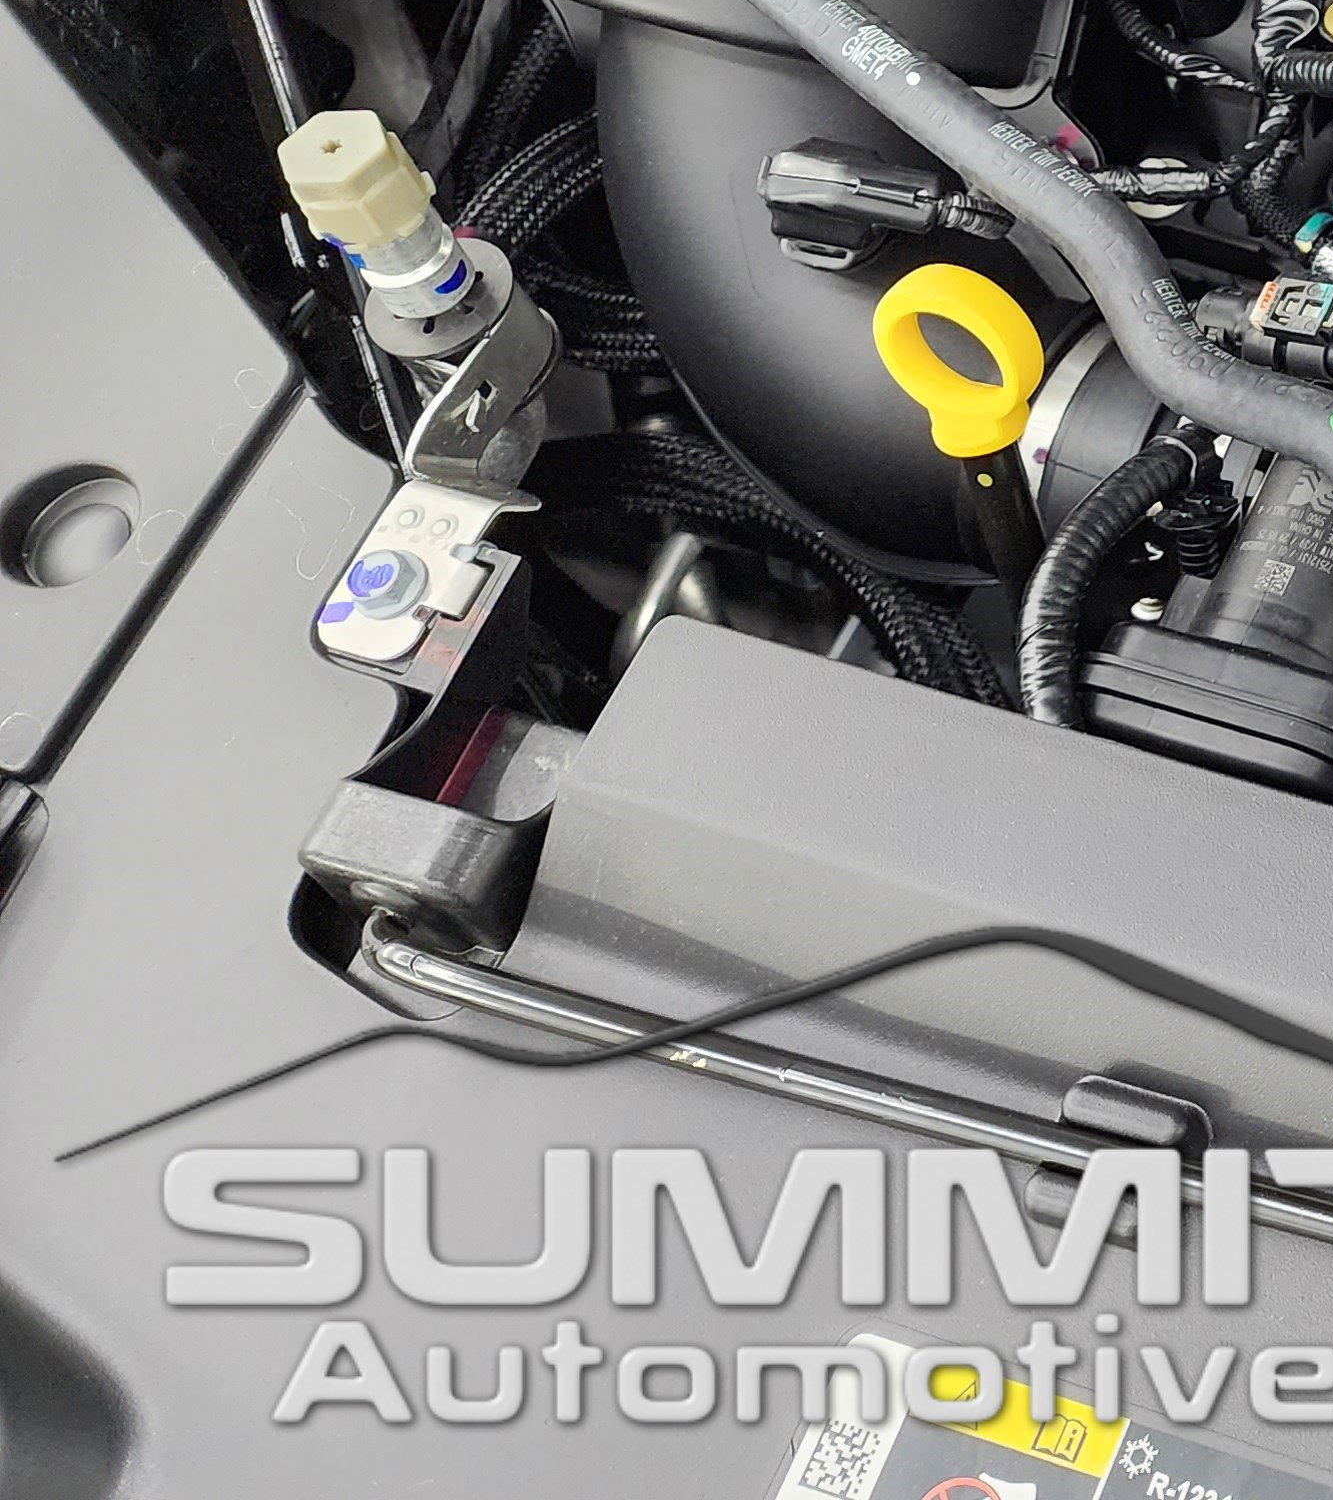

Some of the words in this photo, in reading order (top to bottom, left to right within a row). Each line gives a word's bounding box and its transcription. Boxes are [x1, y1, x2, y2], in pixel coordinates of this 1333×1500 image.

[987, 120, 1038, 154] HEATER
[1152, 277, 1189, 320] HEATER
[1289, 521, 1311, 537] CHINA
[1312, 529, 1324, 541] IN
